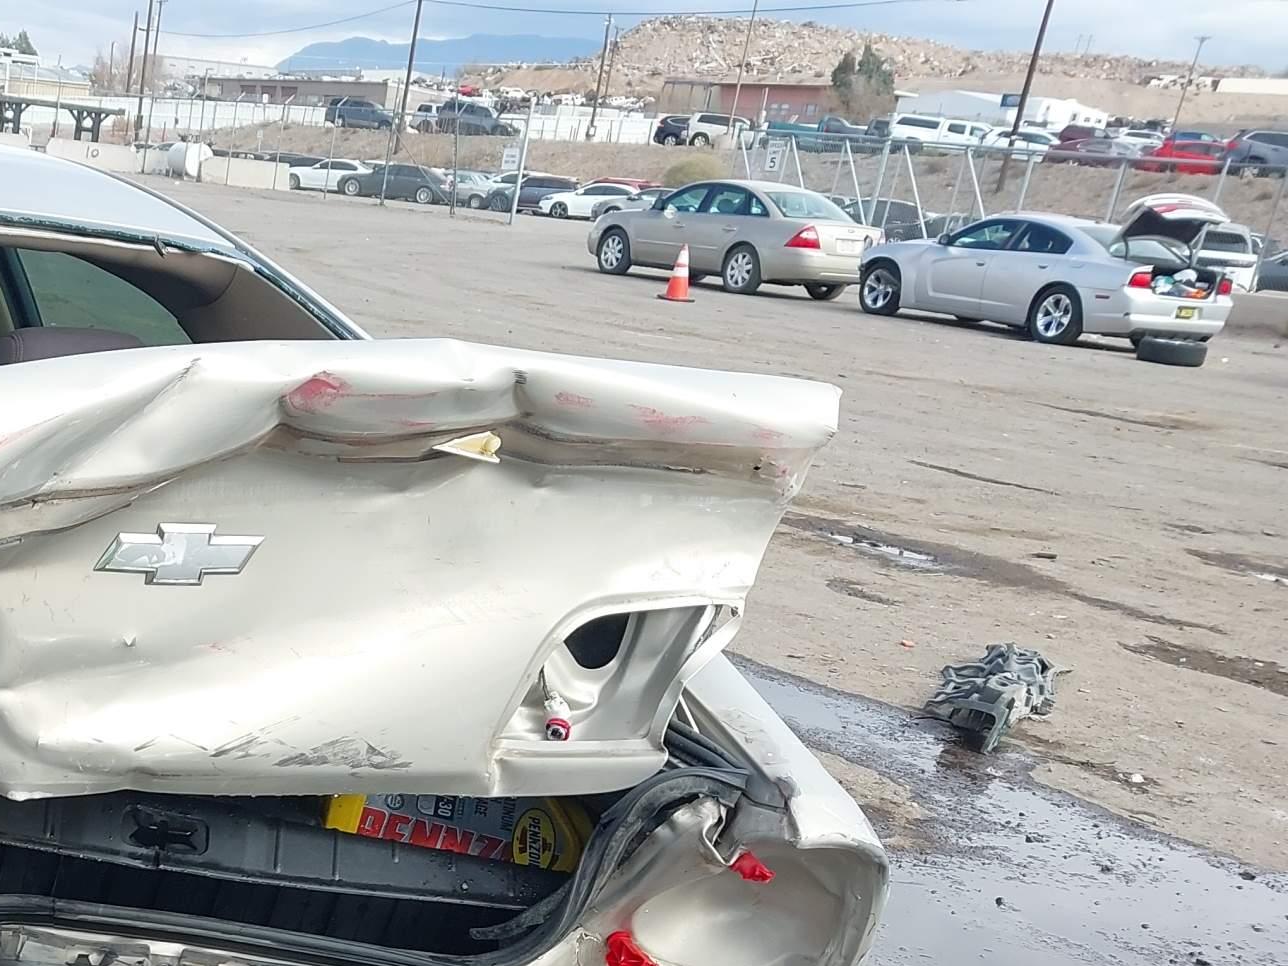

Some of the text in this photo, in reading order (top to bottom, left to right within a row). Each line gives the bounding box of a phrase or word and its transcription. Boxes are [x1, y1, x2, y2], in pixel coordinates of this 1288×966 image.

[769, 156, 777, 169] 5
[358, 806, 513, 861] PENNZ
[528, 816, 541, 867] PENNZOI
